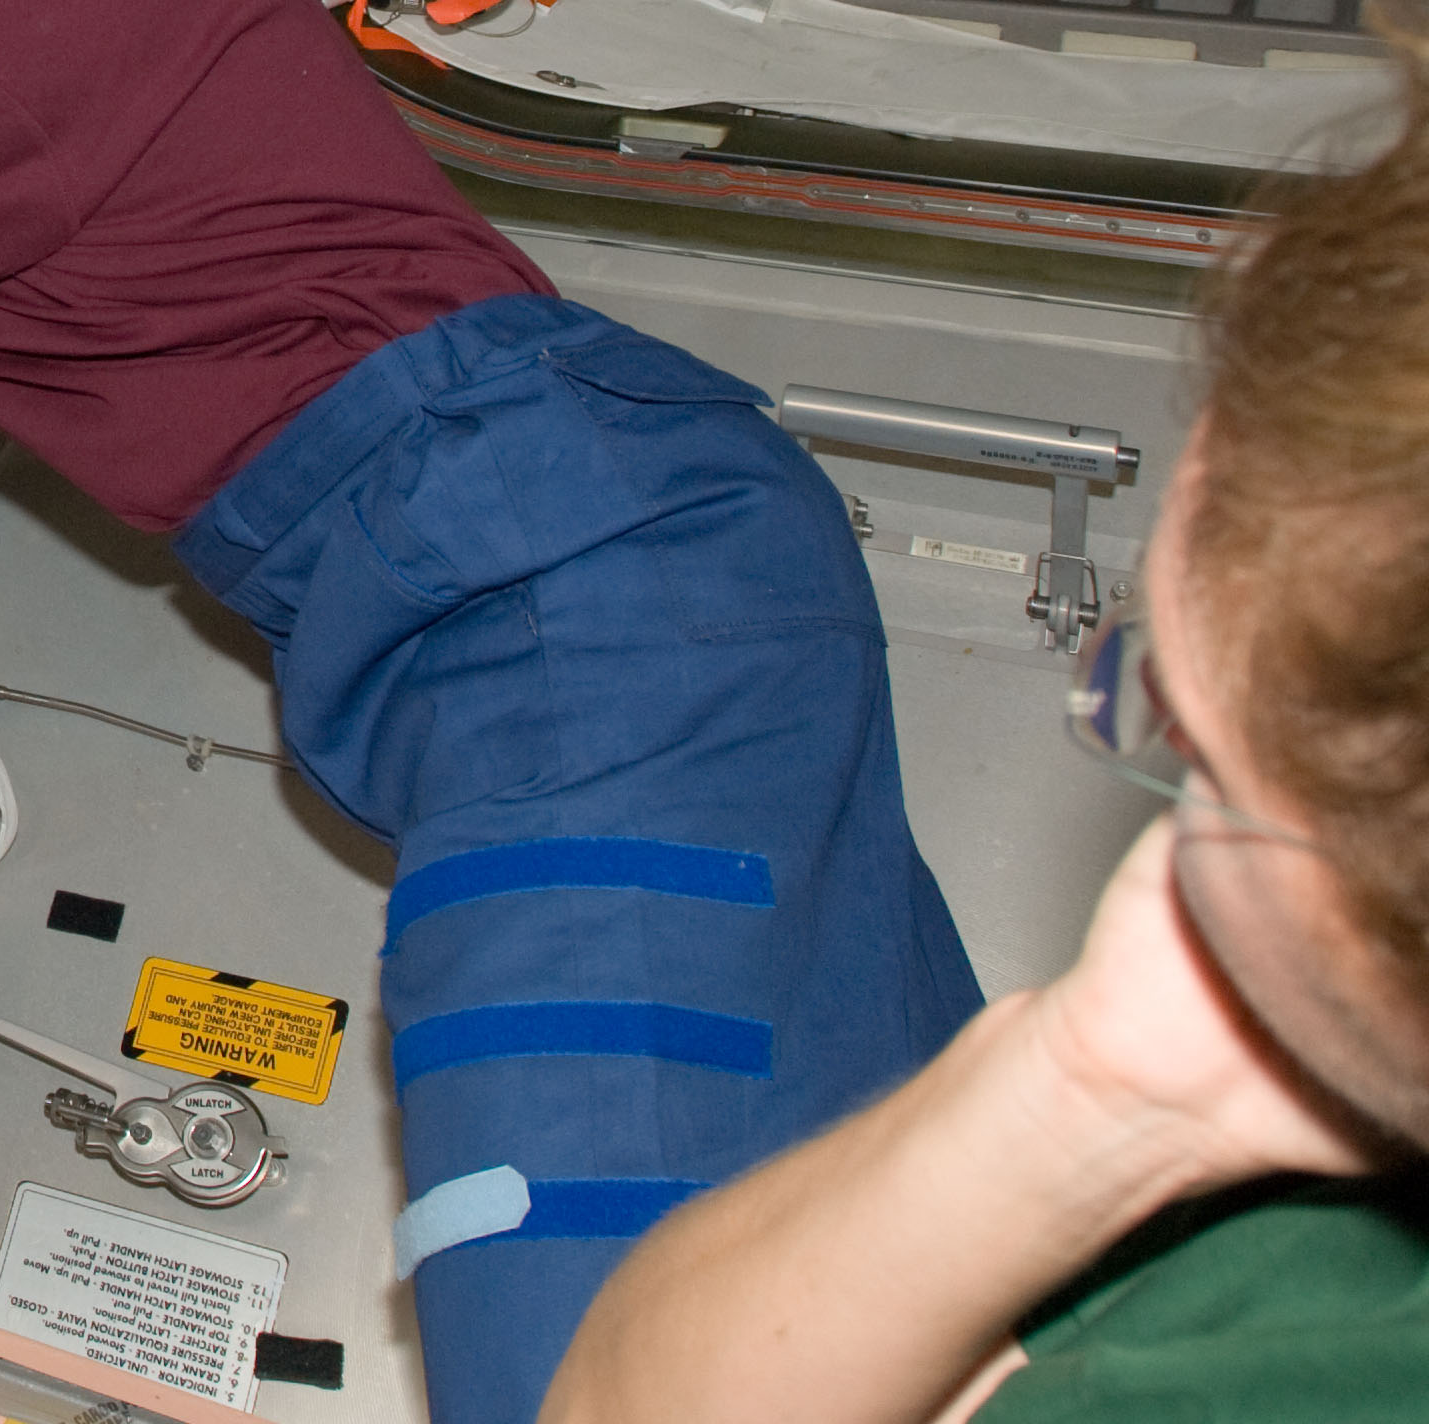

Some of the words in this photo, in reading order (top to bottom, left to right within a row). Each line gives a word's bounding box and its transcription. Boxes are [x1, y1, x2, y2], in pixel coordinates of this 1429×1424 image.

[166, 994, 186, 1005] AND
[212, 994, 258, 1012] DAMAGE.
[148, 1010, 200, 1031] PRESSURE
[179, 1009, 201, 1020] CAN
[191, 1004, 228, 1018] INJURY
[230, 1012, 260, 1024] CREW
[263, 1007, 322, 1026] EQUIPMENT
[202, 1026, 252, 1042] EQUALIZE
[204, 1015, 271, 1037] UNLATCHING
[279, 1022, 320, 1037] RESULT
[255, 1038, 268, 1047] TO
[274, 1032, 318, 1048] BEFORE
[179, 1032, 277, 1070] WARNING
[272, 1042, 315, 1059] FAILURE
[185, 1098, 232, 1109] UNLATCH
[191, 1168, 224, 1178] LATCH
[49, 1251, 91, 1270] position.
[109, 1242, 152, 1262] HANDLE
[23, 1258, 50, 1274] Move
[105, 1255, 149, 1276] BUTTON
[154, 1255, 187, 1272] LATCH
[94, 1265, 132, 1283] stowed
[150, 1269, 184, 1286] LATCH
[189, 1266, 244, 1289] STOWAGE
[100, 1281, 142, 1304] HANDLE
[146, 1282, 178, 1298] travel
[187, 1280, 241, 1303] STOWAGE
[8, 1294, 48, 1316] CLOSED.
[133, 1305, 152, 1318] Pull
[144, 1295, 177, 1312] LATCH
[57, 1310, 87, 1327] VALVE
[163, 1314, 206, 1335] HANDLE
[180, 1306, 234, 1329] STOWAGE
[42, 1319, 85, 1338] position.
[91, 1321, 169, 1353] EQUALIZATION
[137, 1320, 170, 1339] LATCH
[209, 1329, 231, 1343] TOP
[87, 1334, 126, 1353] Stowed
[180, 1335, 227, 1356] RATCHET
[84, 1346, 149, 1375] UNLATCHED.
[135, 1349, 178, 1369] HANDLE
[172, 1345, 224, 1370] PRESSURE
[182, 1363, 221, 1383] CRANK
[158, 1370, 218, 1398] INDICATOR
